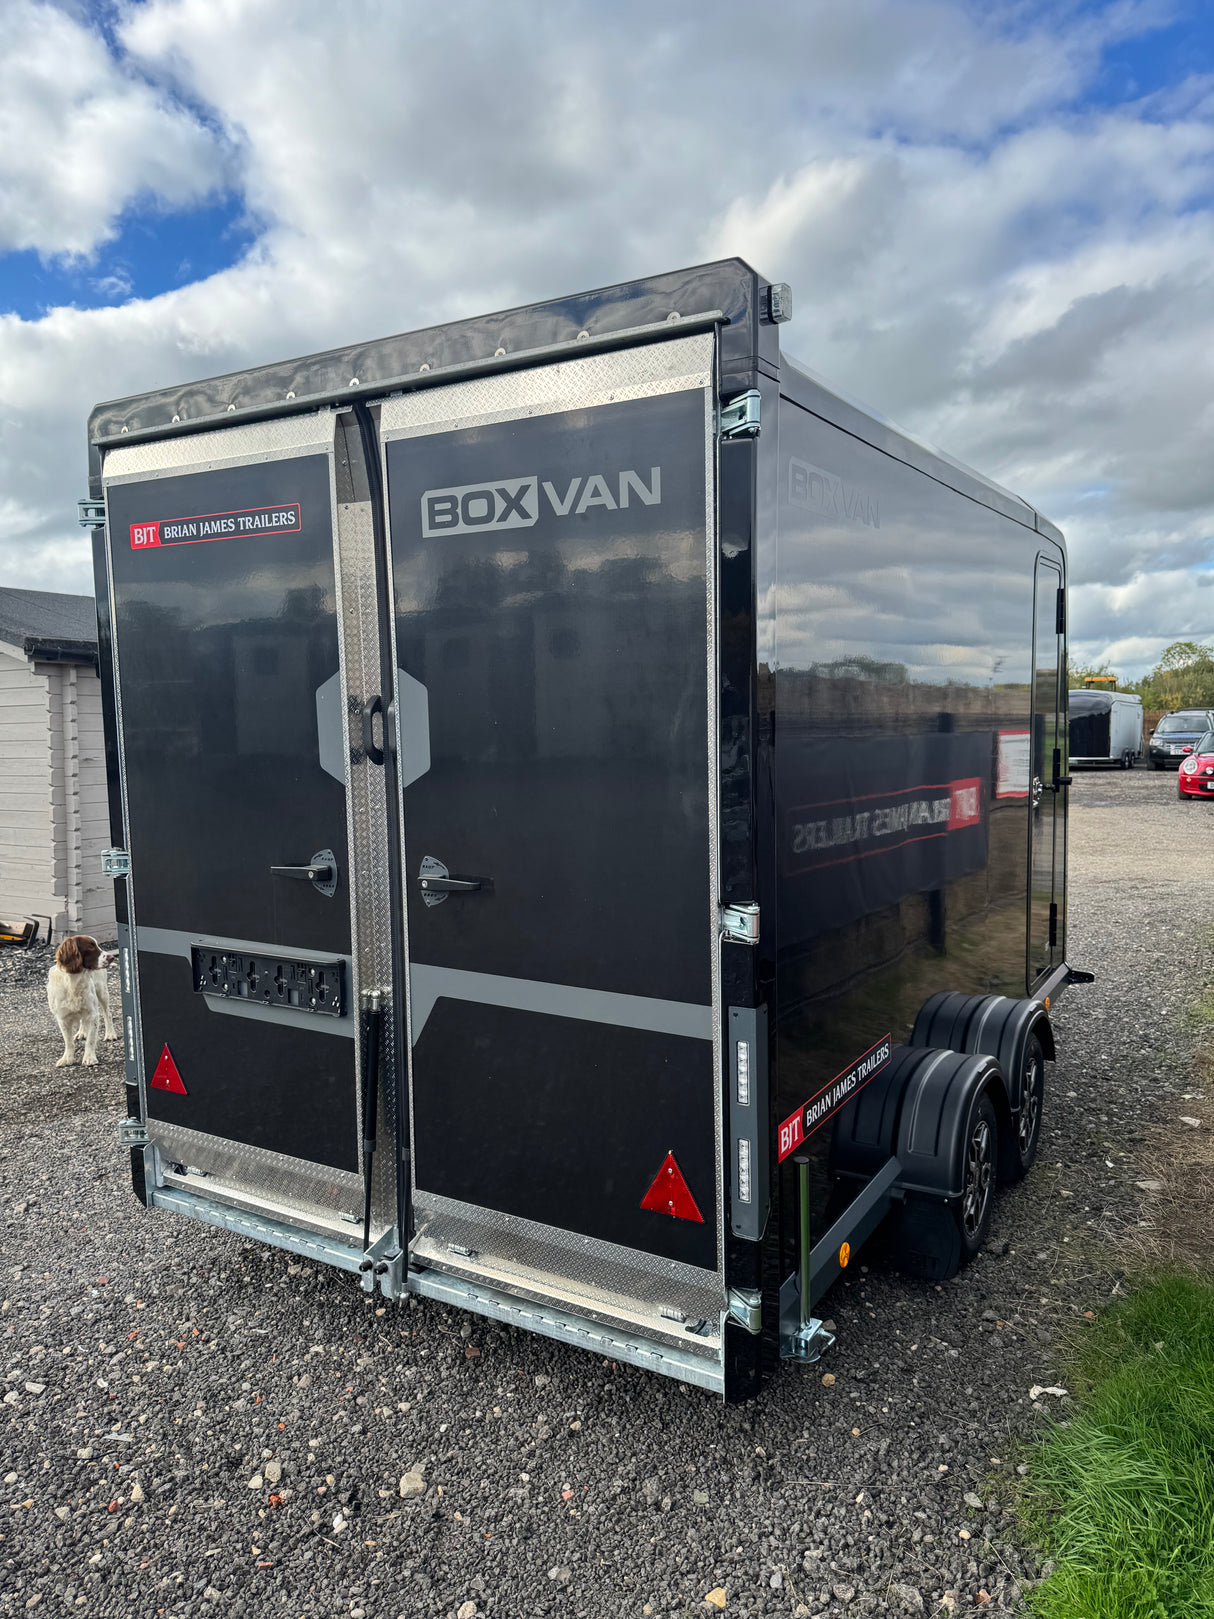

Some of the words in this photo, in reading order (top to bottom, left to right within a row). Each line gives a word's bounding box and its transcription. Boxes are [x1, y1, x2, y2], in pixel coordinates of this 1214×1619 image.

[134, 526, 156, 545] BJT
[164, 523, 197, 539] BRIAN
[199, 518, 236, 537] JAMES
[238, 511, 296, 531] TRAILERS
[425, 466, 661, 533] BOXVAN
[780, 1115, 801, 1154] BJT
[806, 1091, 832, 1128] BRIAN
[833, 1070, 857, 1107] JAMES
[857, 1043, 890, 1081] TRAILERS
